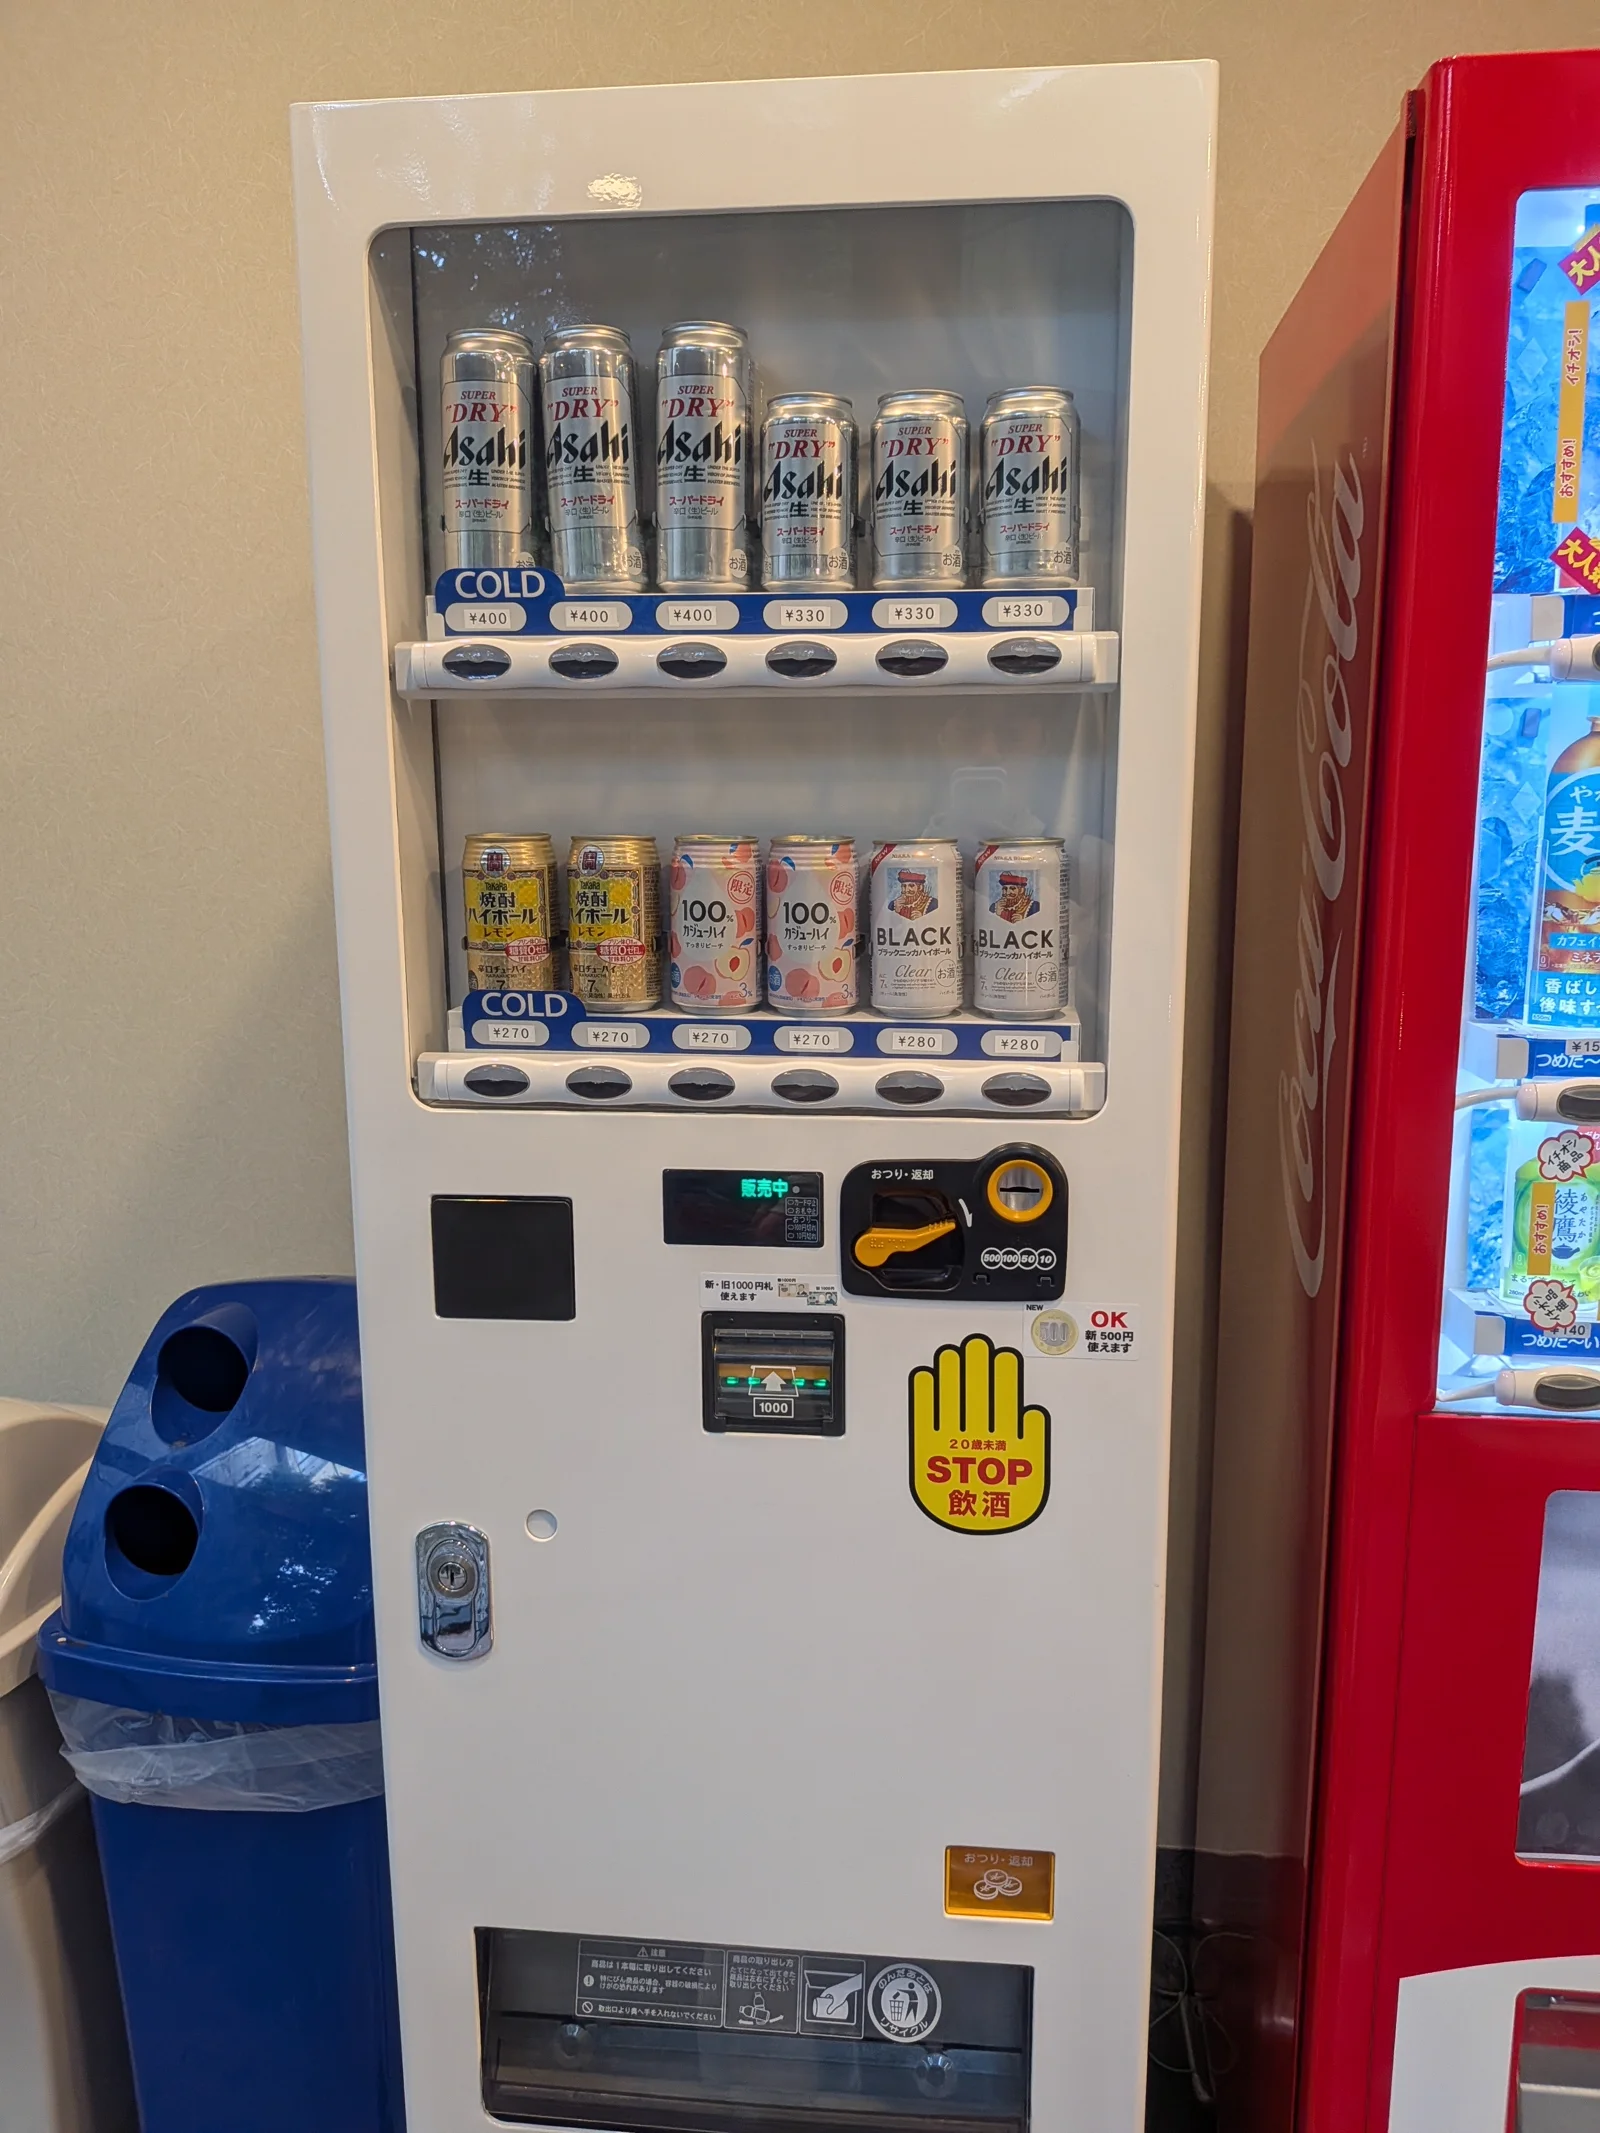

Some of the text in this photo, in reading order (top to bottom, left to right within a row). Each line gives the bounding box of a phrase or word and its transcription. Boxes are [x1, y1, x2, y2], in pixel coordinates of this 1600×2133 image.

[461, 390, 497, 401] SUPER
[562, 386, 598, 397] SUPER
[677, 385, 714, 396] SUPER
[784, 428, 818, 438] SUPER
[897, 426, 931, 436] SUPER
[1008, 424, 1042, 434] SUPER
[443, 425, 526, 470] Asahi
[547, 421, 629, 469] Asahi
[657, 420, 741, 466] Asahi
[468, 469, 490, 486] 生
[574, 465, 596, 483] 生
[684, 464, 706, 482] 生
[764, 460, 843, 501] Asahi
[875, 458, 956, 500] Asahi
[986, 456, 1067, 498] Asahi
[455, 498, 510, 510] スーパードライ
[560, 494, 615, 507] スーパードライ
[669, 495, 724, 507] スーパードライ
[903, 500, 923, 516] 生
[1014, 498, 1034, 514] 生
[789, 501, 810, 518] 生
[776, 525, 825, 536] スーパードライ
[890, 525, 939, 535] スーパードライ
[1000, 522, 1050, 533] スーパードライ
[729, 555, 747, 572] お酒
[828, 554, 847, 570] お酒
[942, 551, 960, 568] お酒
[1054, 551, 1071, 566] お酒
[455, 570, 545, 598] COLD
[570, 610, 608, 623] ¥400
[673, 609, 712, 622] ¥400
[785, 609, 825, 623] ¥330
[894, 607, 934, 620] ¥330
[1003, 604, 1043, 617] ¥330
[469, 612, 507, 625] ¥400
[875, 847, 888, 864] NEW
[978, 849, 992, 865] NEW
[730, 878, 753, 896] 限定
[833, 879, 853, 896] 限定
[480, 892, 515, 907] 焼酎
[576, 891, 608, 907] 焼酎
[469, 908, 538, 925] ハイボール
[682, 900, 734, 924] 100%
[782, 901, 836, 925] 100%
[484, 927, 515, 937] レモン
[578, 926, 606, 937] レモン
[682, 924, 727, 939] カジューハイ
[784, 925, 829, 941] カジューハイ
[877, 927, 951, 946] BLACK
[979, 930, 1054, 949] BLACK
[877, 948, 951, 957] ブラックニッカハイボール
[979, 950, 1054, 960] ブラックニッカハイボール
[895, 964, 932, 978] Clear
[937, 965, 955, 980] お酒
[1037, 969, 1057, 983] お酒
[739, 983, 753, 997] 3%
[841, 983, 854, 999] 3%
[482, 992, 567, 1017] COLD
[493, 1026, 529, 1039] ¥270
[592, 1031, 629, 1044] ¥270
[692, 1032, 729, 1045] ¥270
[793, 1033, 830, 1046] ¥270
[898, 1036, 936, 1048] ¥280
[1001, 1038, 1039, 1051] ¥280
[1548, 1139, 1577, 1166] イチオシ
[1557, 1150, 1584, 1173] 商品
[871, 1169, 934, 1180] おつり・返却
[741, 1178, 789, 1199] 販売中
[1552, 1189, 1579, 1243] 綾鷹
[1577, 1193, 1588, 1239] あやたか
[983, 1255, 1000, 1263] 500
[1002, 1255, 1018, 1264] 100
[1020, 1255, 1036, 1264] 50
[1039, 1255, 1052, 1264] 10
[705, 1280, 773, 1290] 新・旧1000円札
[720, 1292, 757, 1301] 使えます
[1545, 1288, 1569, 1312] 商品
[1533, 1295, 1560, 1321] イチオシ
[1090, 1310, 1128, 1328] OK
[1087, 1342, 1132, 1353] 使えます
[759, 1403, 788, 1413] 1000
[949, 1439, 1007, 1451] 20歳未満
[927, 1455, 1033, 1486] STOP
[948, 1489, 1011, 1518] 飲酒
[964, 1853, 1033, 1867] おつり・返却
[732, 1955, 794, 1968] 商品の取り出し方
[878, 1967, 933, 1995] のんだあとは
[880, 2018, 928, 2036] リサイクル
